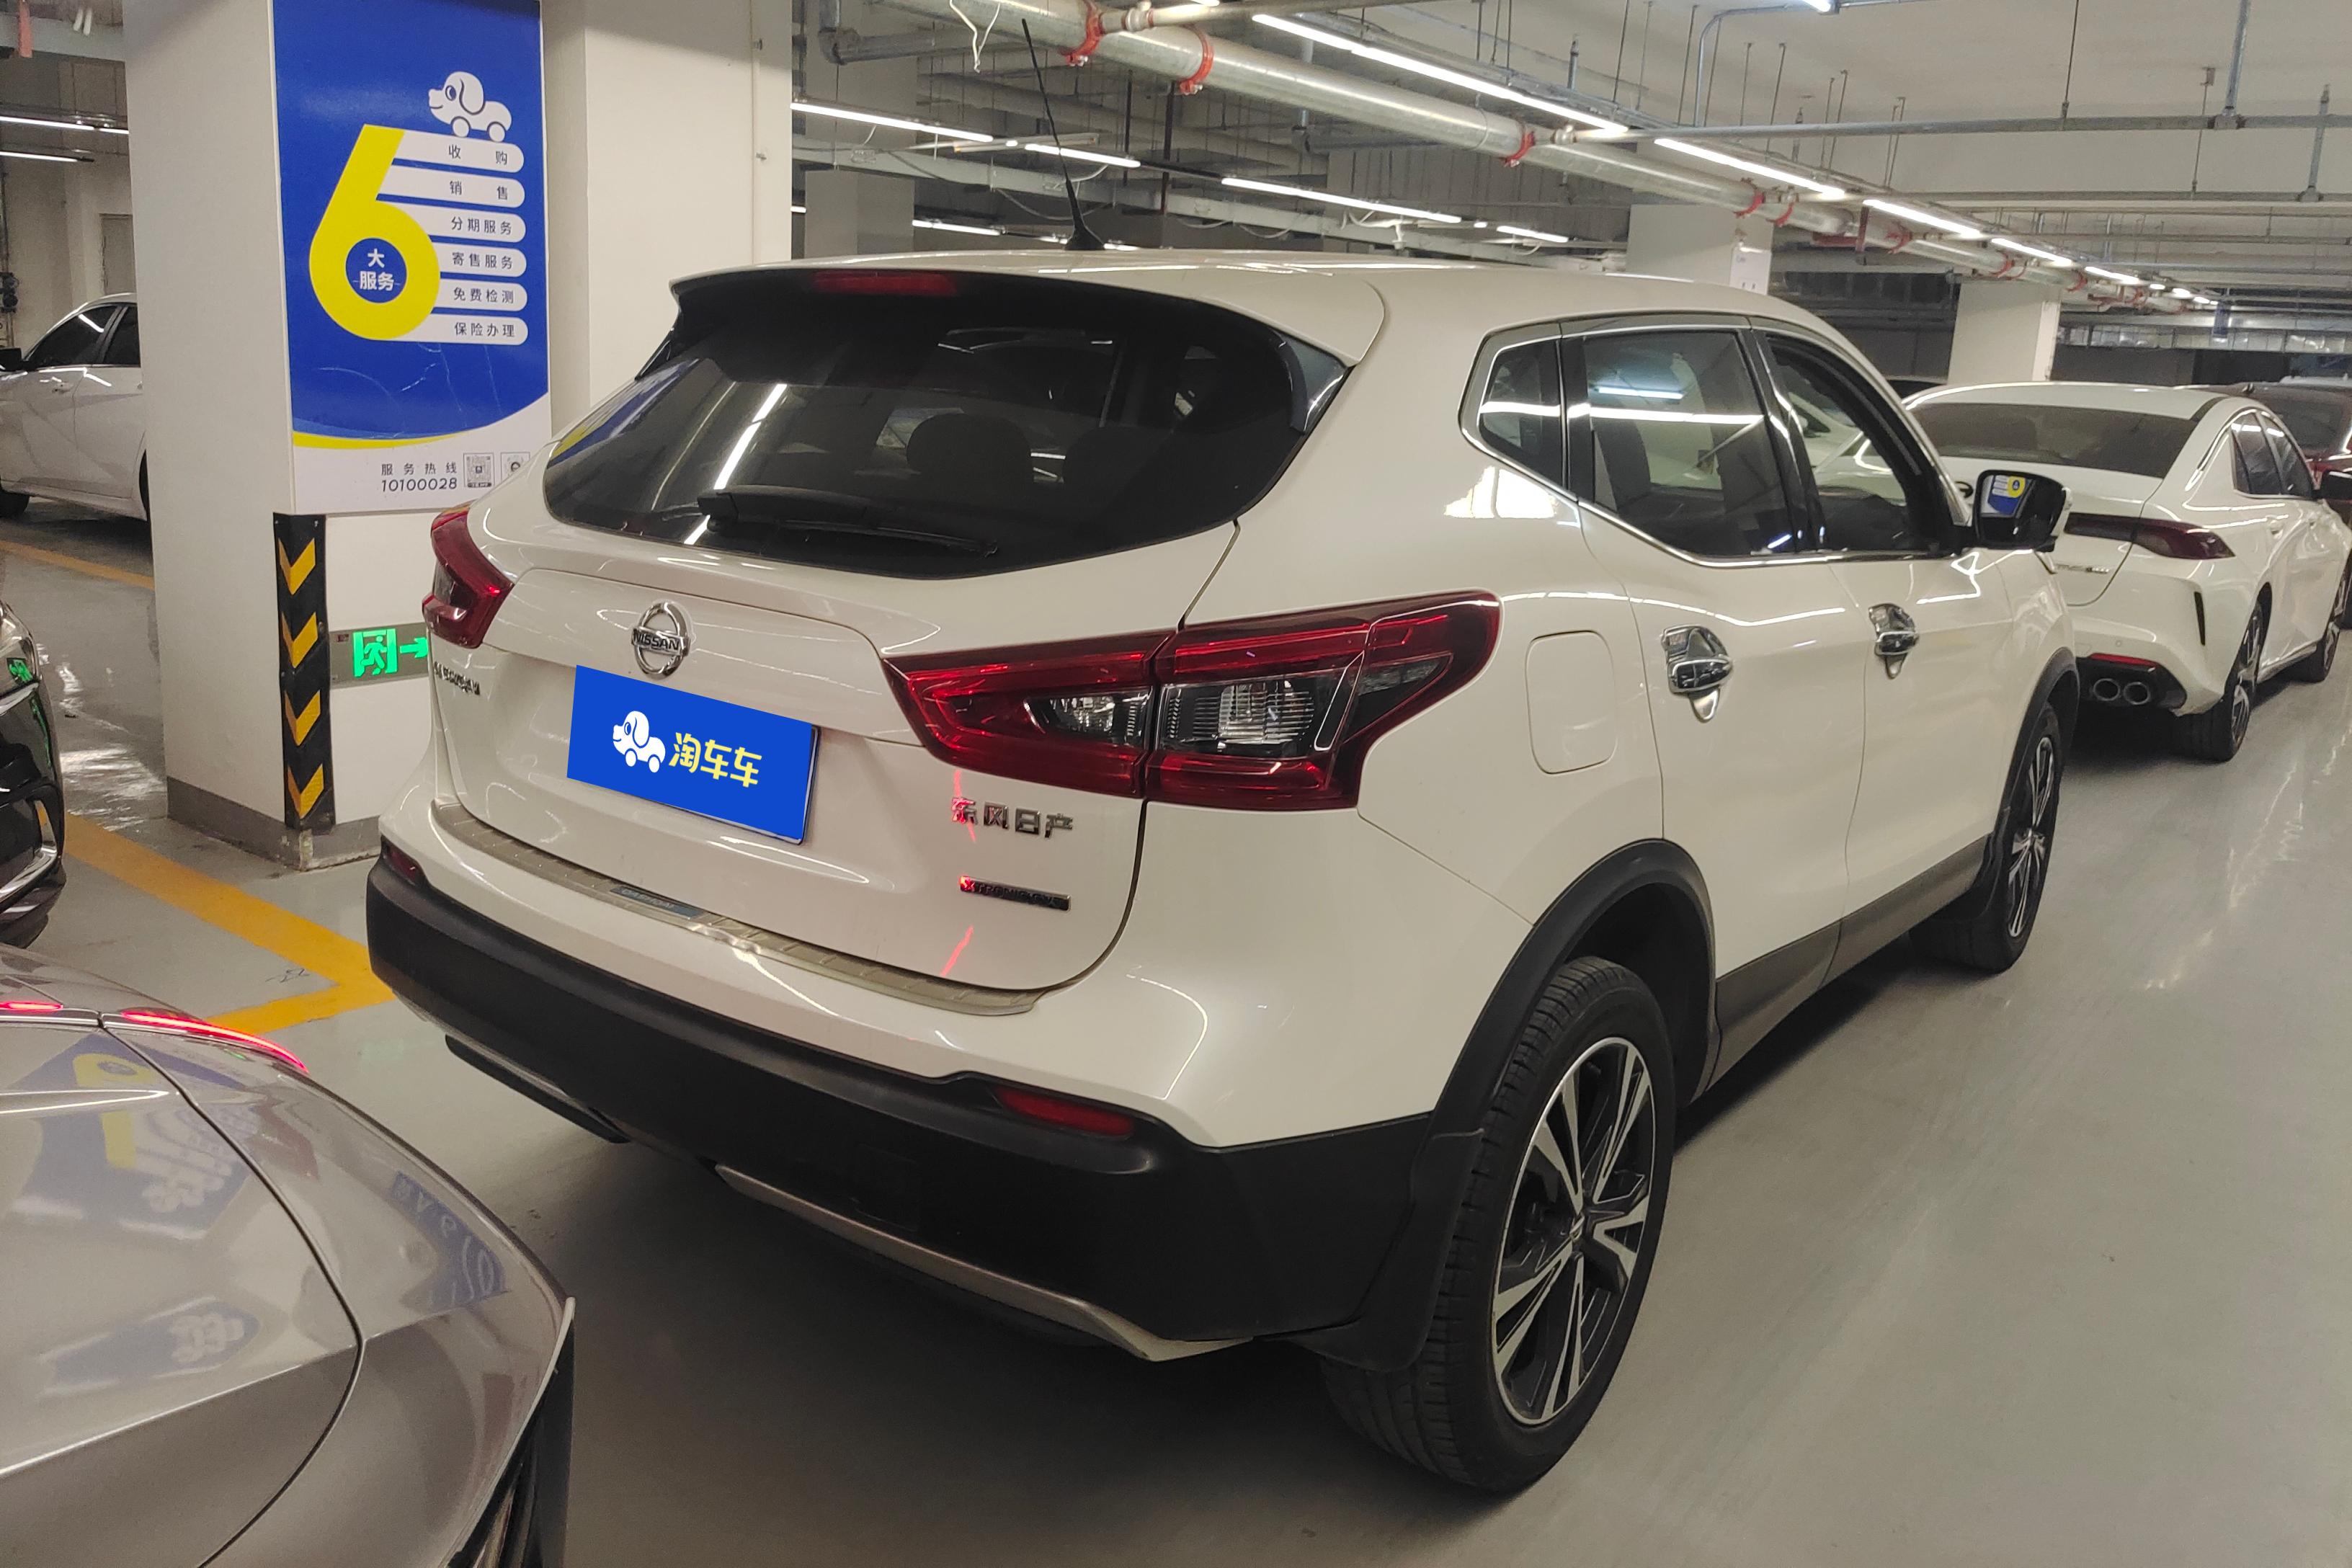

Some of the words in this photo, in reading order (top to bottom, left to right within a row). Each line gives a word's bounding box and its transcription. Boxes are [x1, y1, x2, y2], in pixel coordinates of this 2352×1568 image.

[448, 144, 508, 166] 收购
[449, 180, 509, 200] 销售
[309, 124, 440, 341] 6
[451, 216, 512, 236] 分期服务
[367, 249, 386, 269] 大
[452, 251, 513, 270] 寄售服务
[360, 271, 396, 291] 服务
[453, 287, 514, 304] 免费检测
[454, 321, 515, 338] 保险办理
[380, 462, 458, 476] 服务热线
[381, 477, 458, 492] 10100028
[633, 628, 680, 651] NISSAN
[951, 796, 1073, 838] 东风日产
